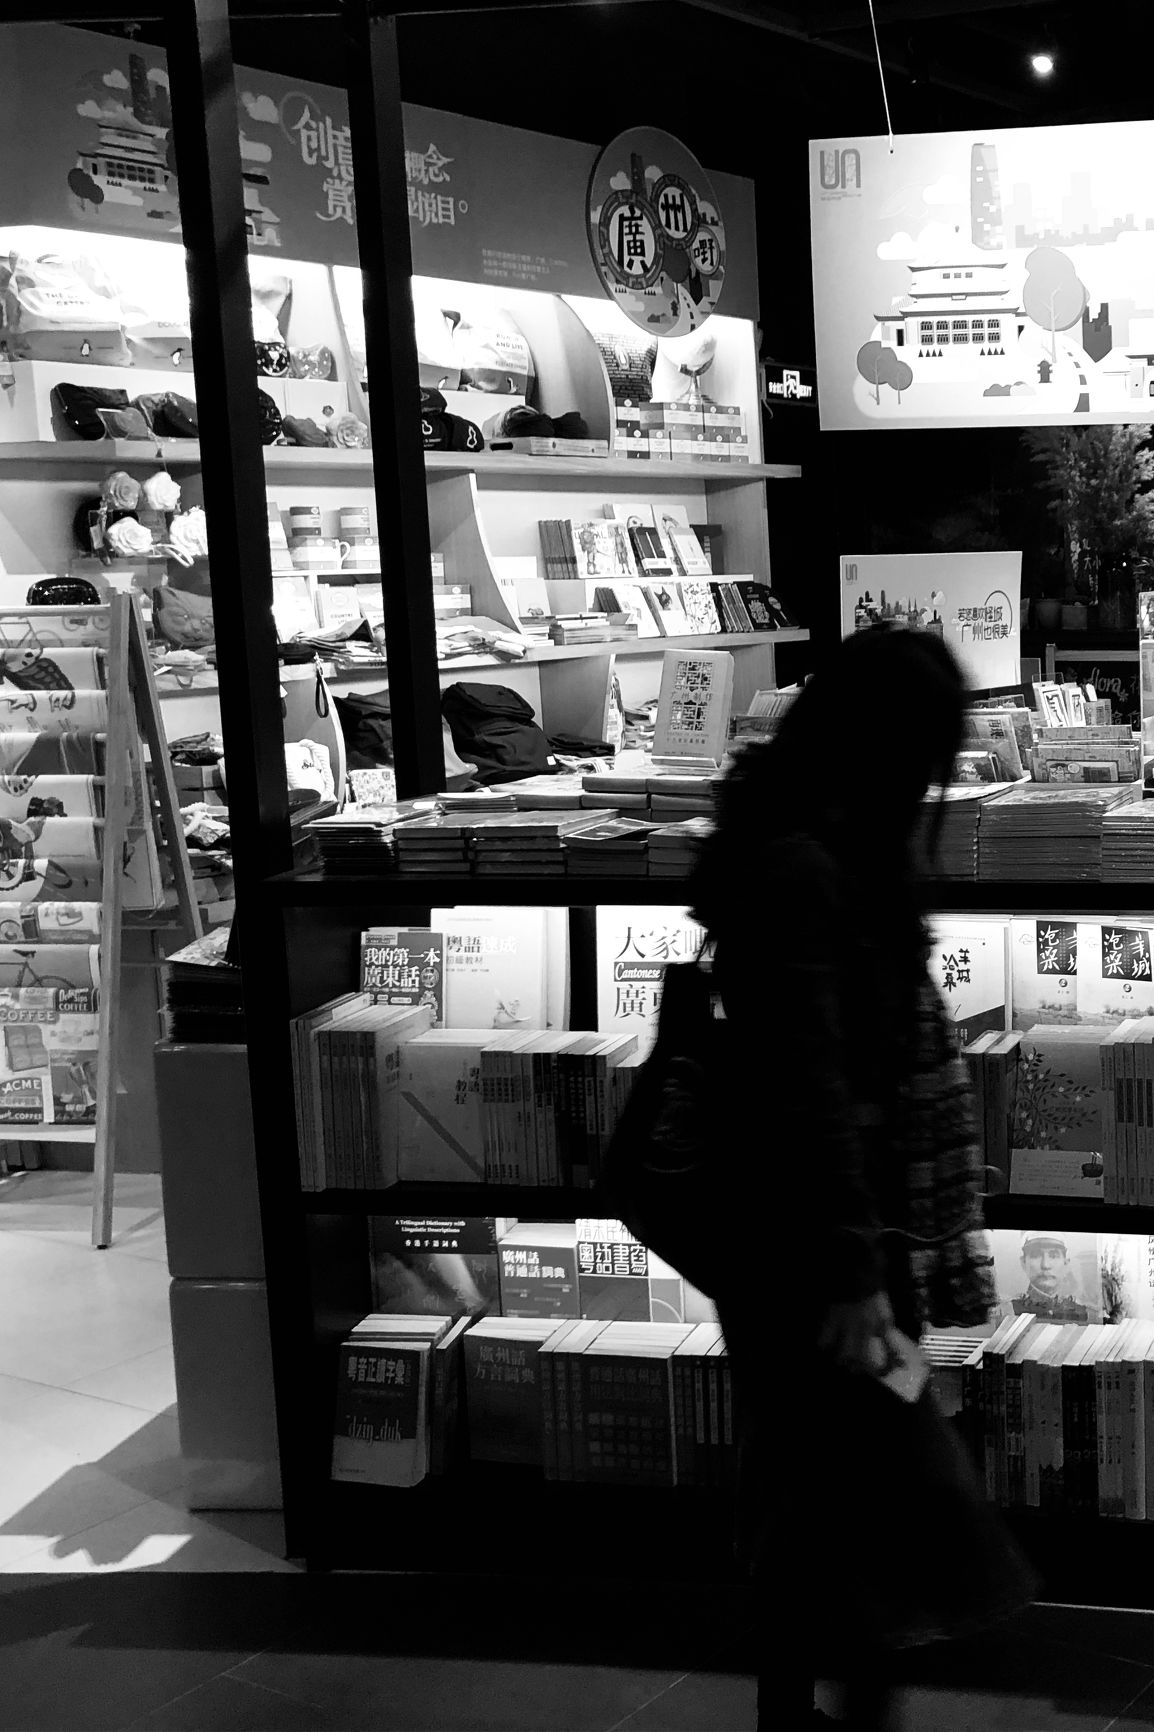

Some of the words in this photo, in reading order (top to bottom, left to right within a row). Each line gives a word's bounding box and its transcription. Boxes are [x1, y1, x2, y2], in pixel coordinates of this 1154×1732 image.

[962, 622, 1011, 643] 广州也很美
[363, 947, 441, 967] 我的第一本
[363, 965, 420, 988] 廣東話
[615, 962, 661, 981] Cantonese
[3, 1079, 41, 1094] ACME
[502, 1249, 540, 1264] 廣州話
[578, 1242, 648, 1276] 粵語書寫
